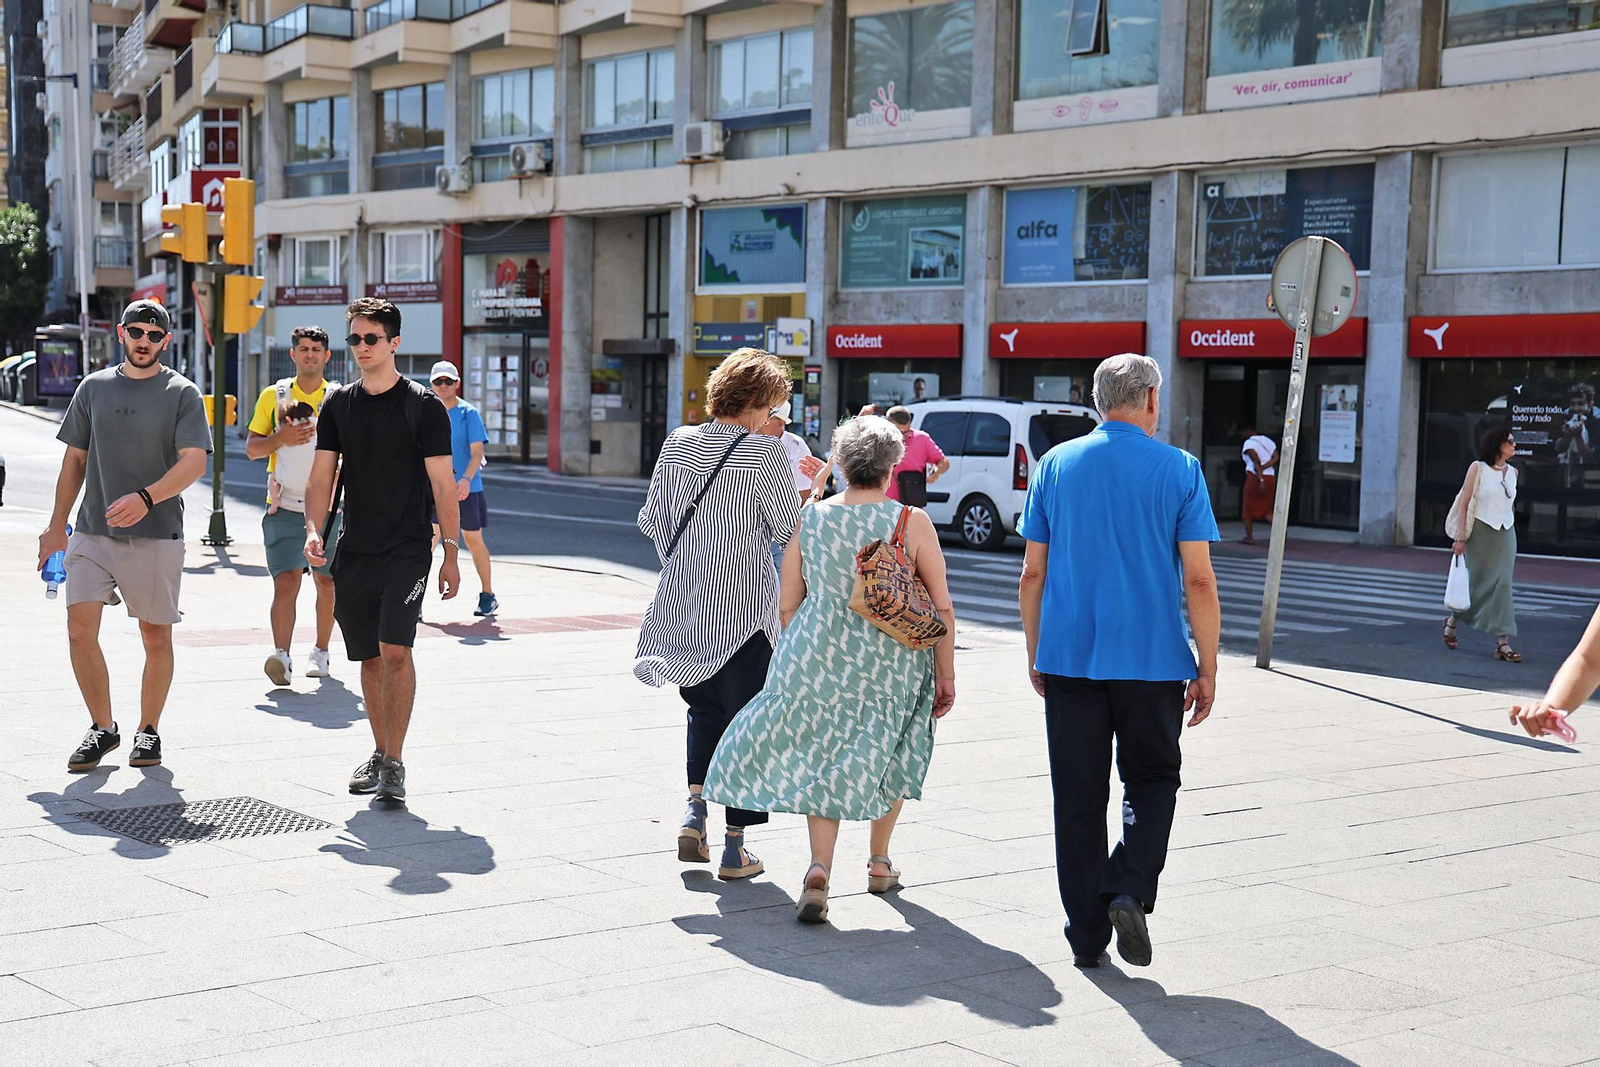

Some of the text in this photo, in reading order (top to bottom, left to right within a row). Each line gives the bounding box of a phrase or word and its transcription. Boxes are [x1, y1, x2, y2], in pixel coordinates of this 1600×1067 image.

[1017, 220, 1058, 240] alfa
[835, 334, 882, 348] Occident
[1190, 330, 1255, 346] Occident
[1512, 404, 1544, 414] Quererlo
[1512, 414, 1528, 422] todo
[1535, 414, 1552, 422] todo
